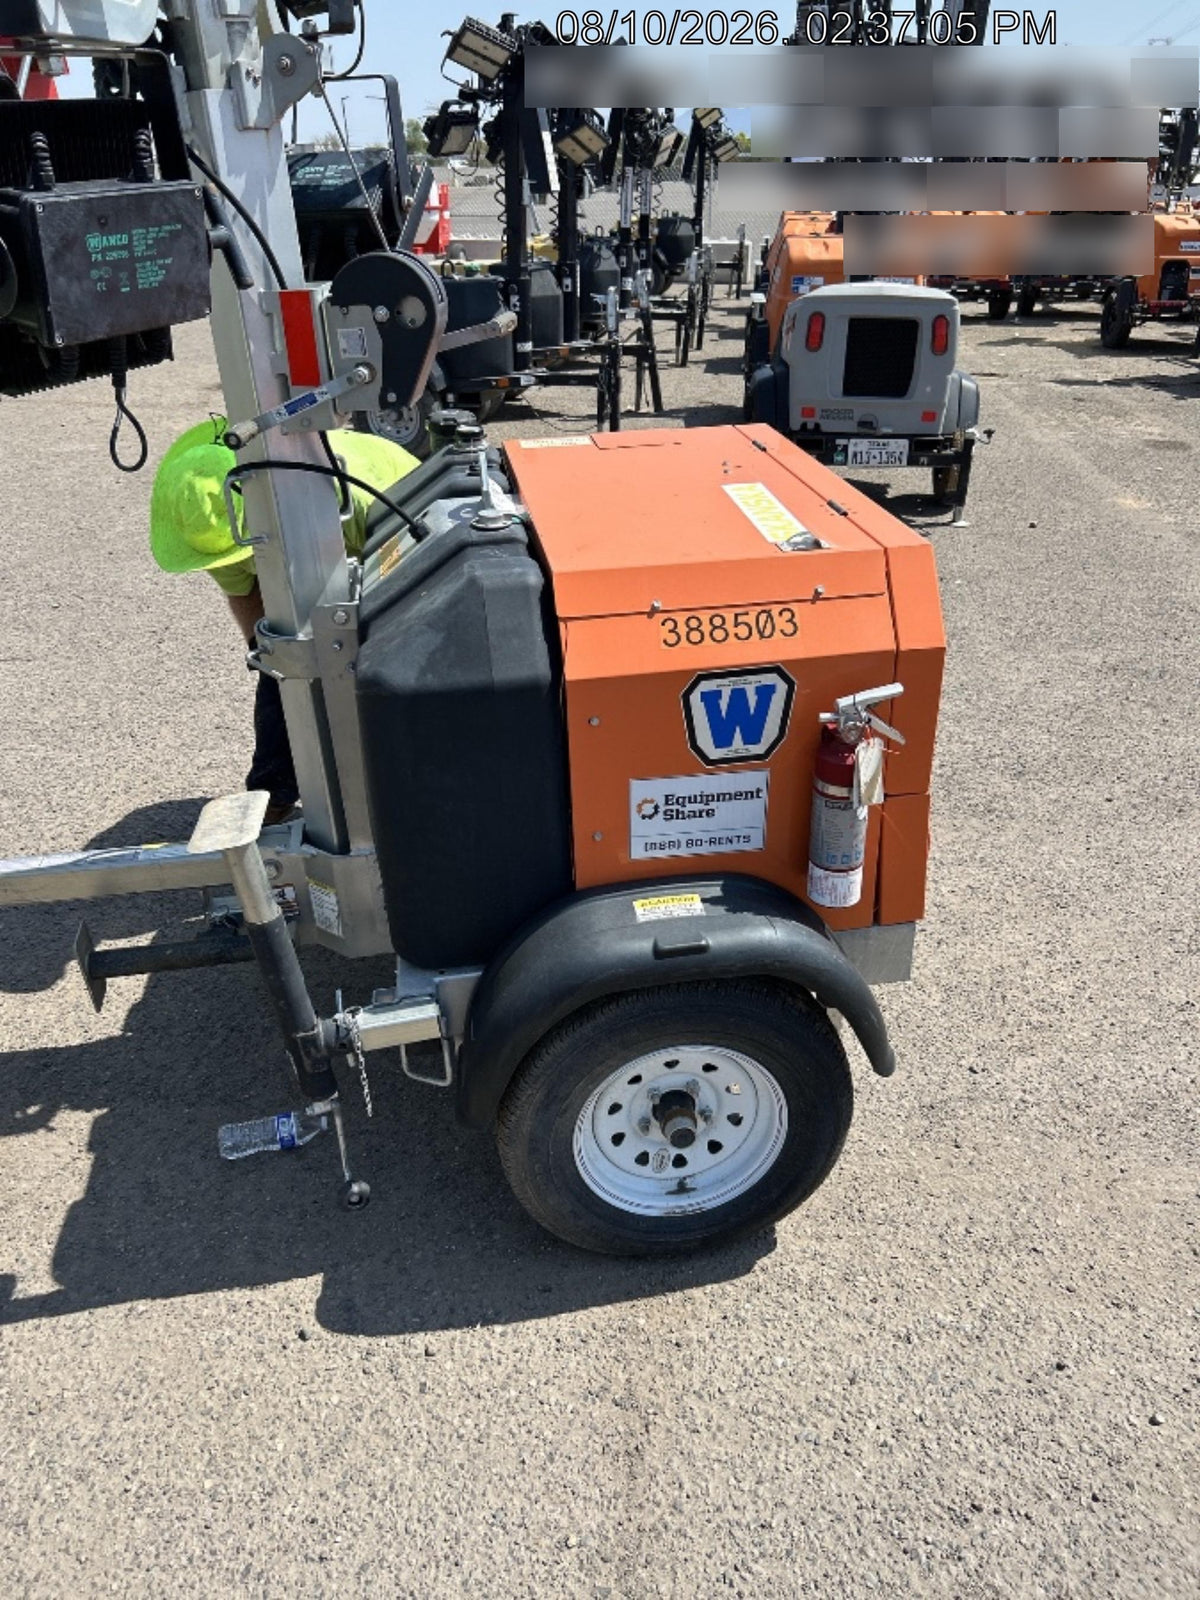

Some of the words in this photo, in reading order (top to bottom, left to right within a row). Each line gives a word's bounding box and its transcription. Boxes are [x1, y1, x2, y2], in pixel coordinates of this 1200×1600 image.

[661, 607, 799, 648] 388503
[700, 683, 777, 749] W
[664, 786, 764, 808] Equipment
[662, 807, 717, 822] Share
